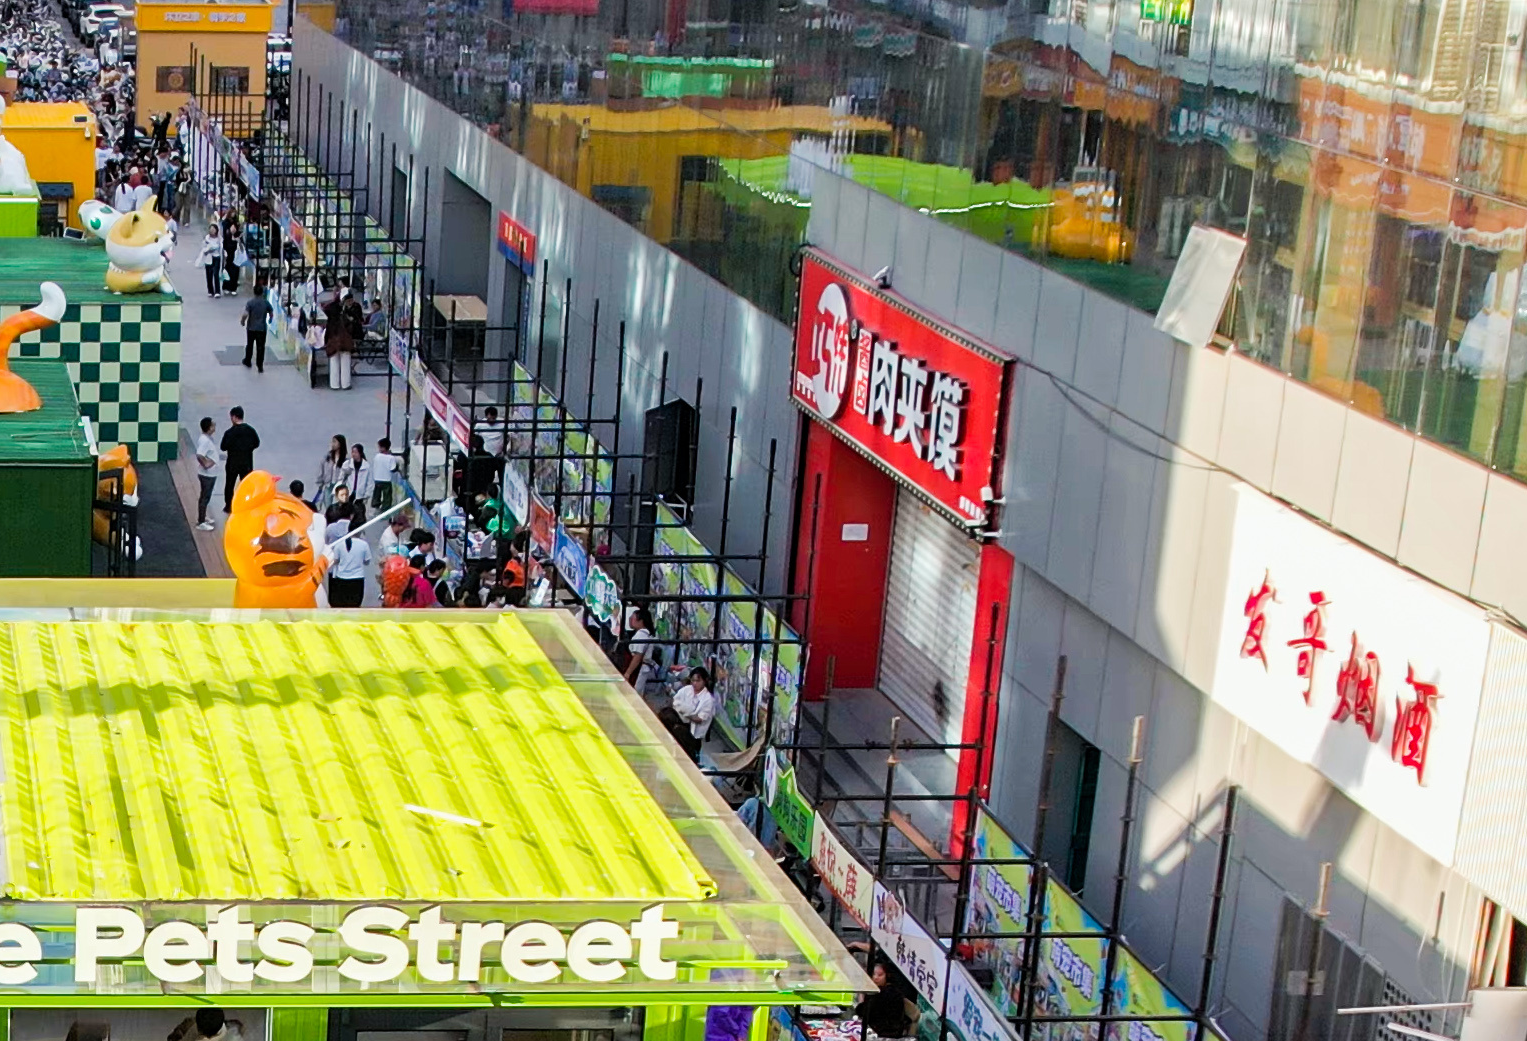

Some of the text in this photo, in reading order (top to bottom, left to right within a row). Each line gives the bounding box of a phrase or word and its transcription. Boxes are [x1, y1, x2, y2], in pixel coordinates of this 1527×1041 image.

[867, 340, 965, 481] 肉夹馍
[1239, 567, 1445, 787] 发哥烟酒
[75, 902, 316, 985] Pets
[337, 901, 679, 985] Street
